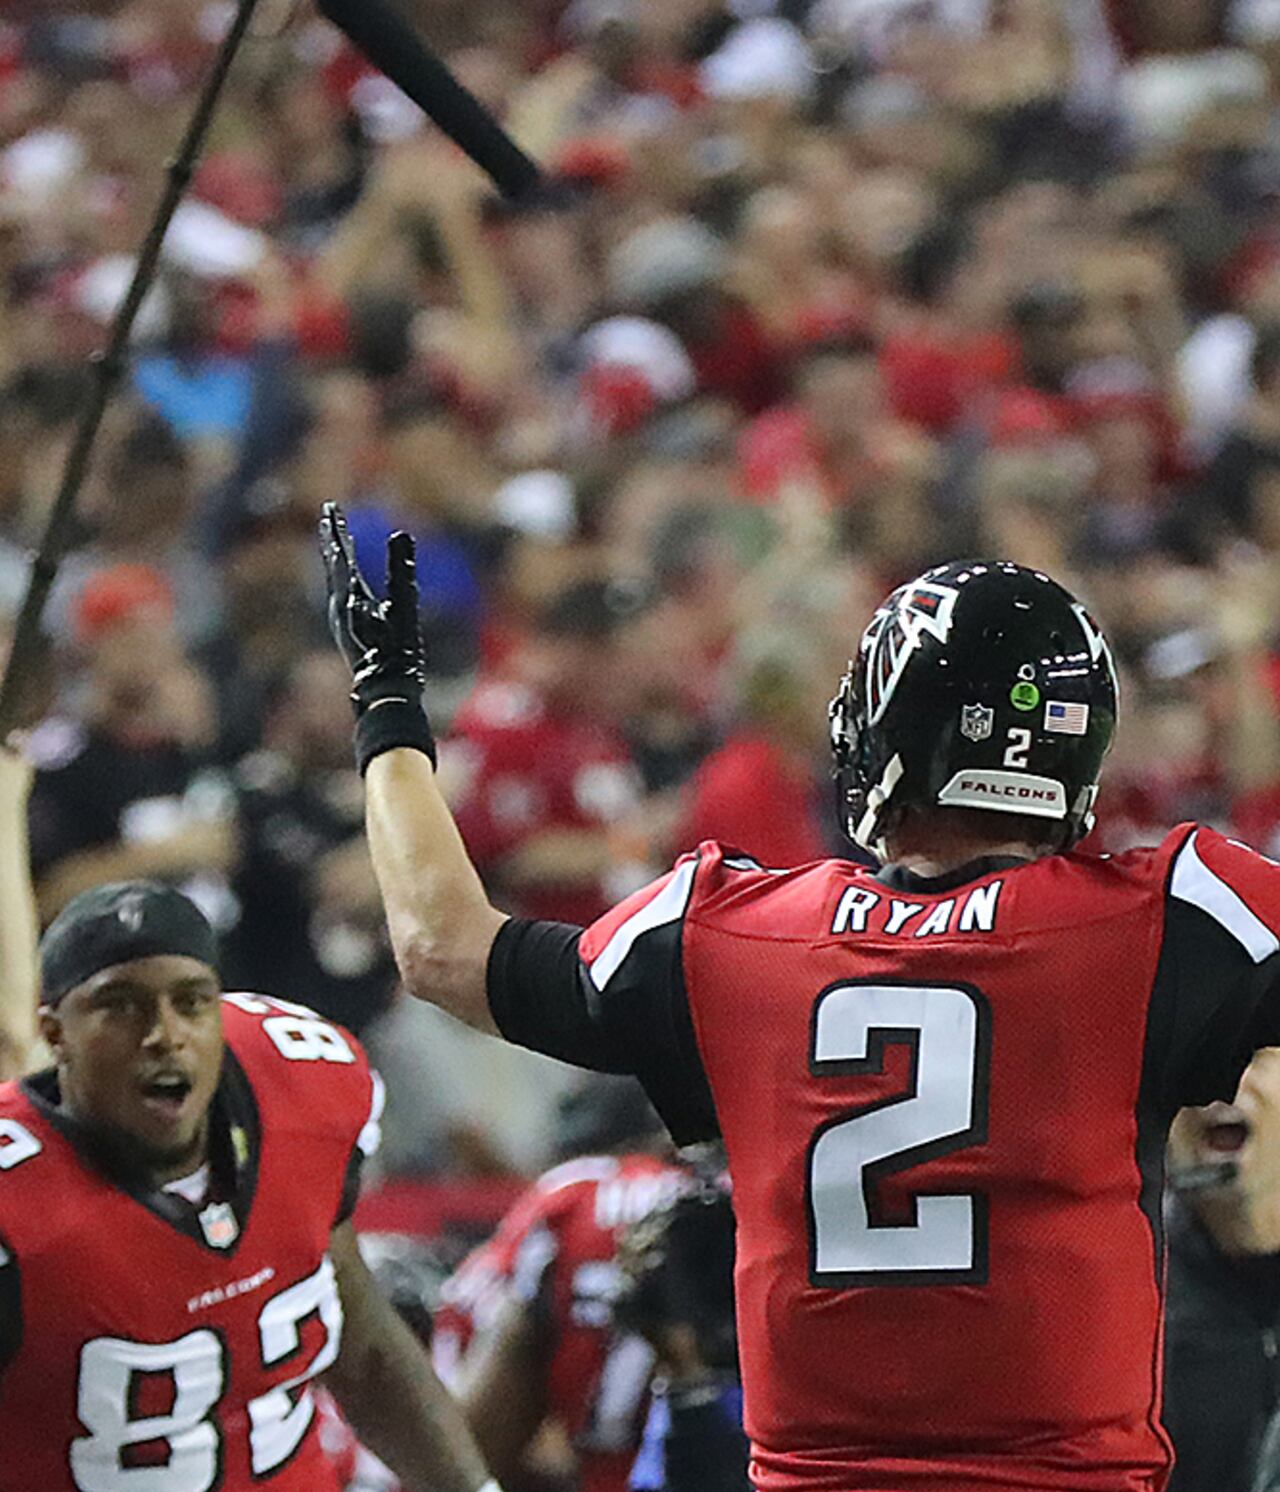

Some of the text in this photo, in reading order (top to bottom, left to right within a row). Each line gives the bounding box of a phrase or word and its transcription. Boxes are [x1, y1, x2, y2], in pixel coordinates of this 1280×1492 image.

[1003, 727, 1032, 768] 2
[960, 781, 1057, 801] FALCONS
[831, 878, 1004, 938] RYAN
[810, 984, 982, 1276] 2
